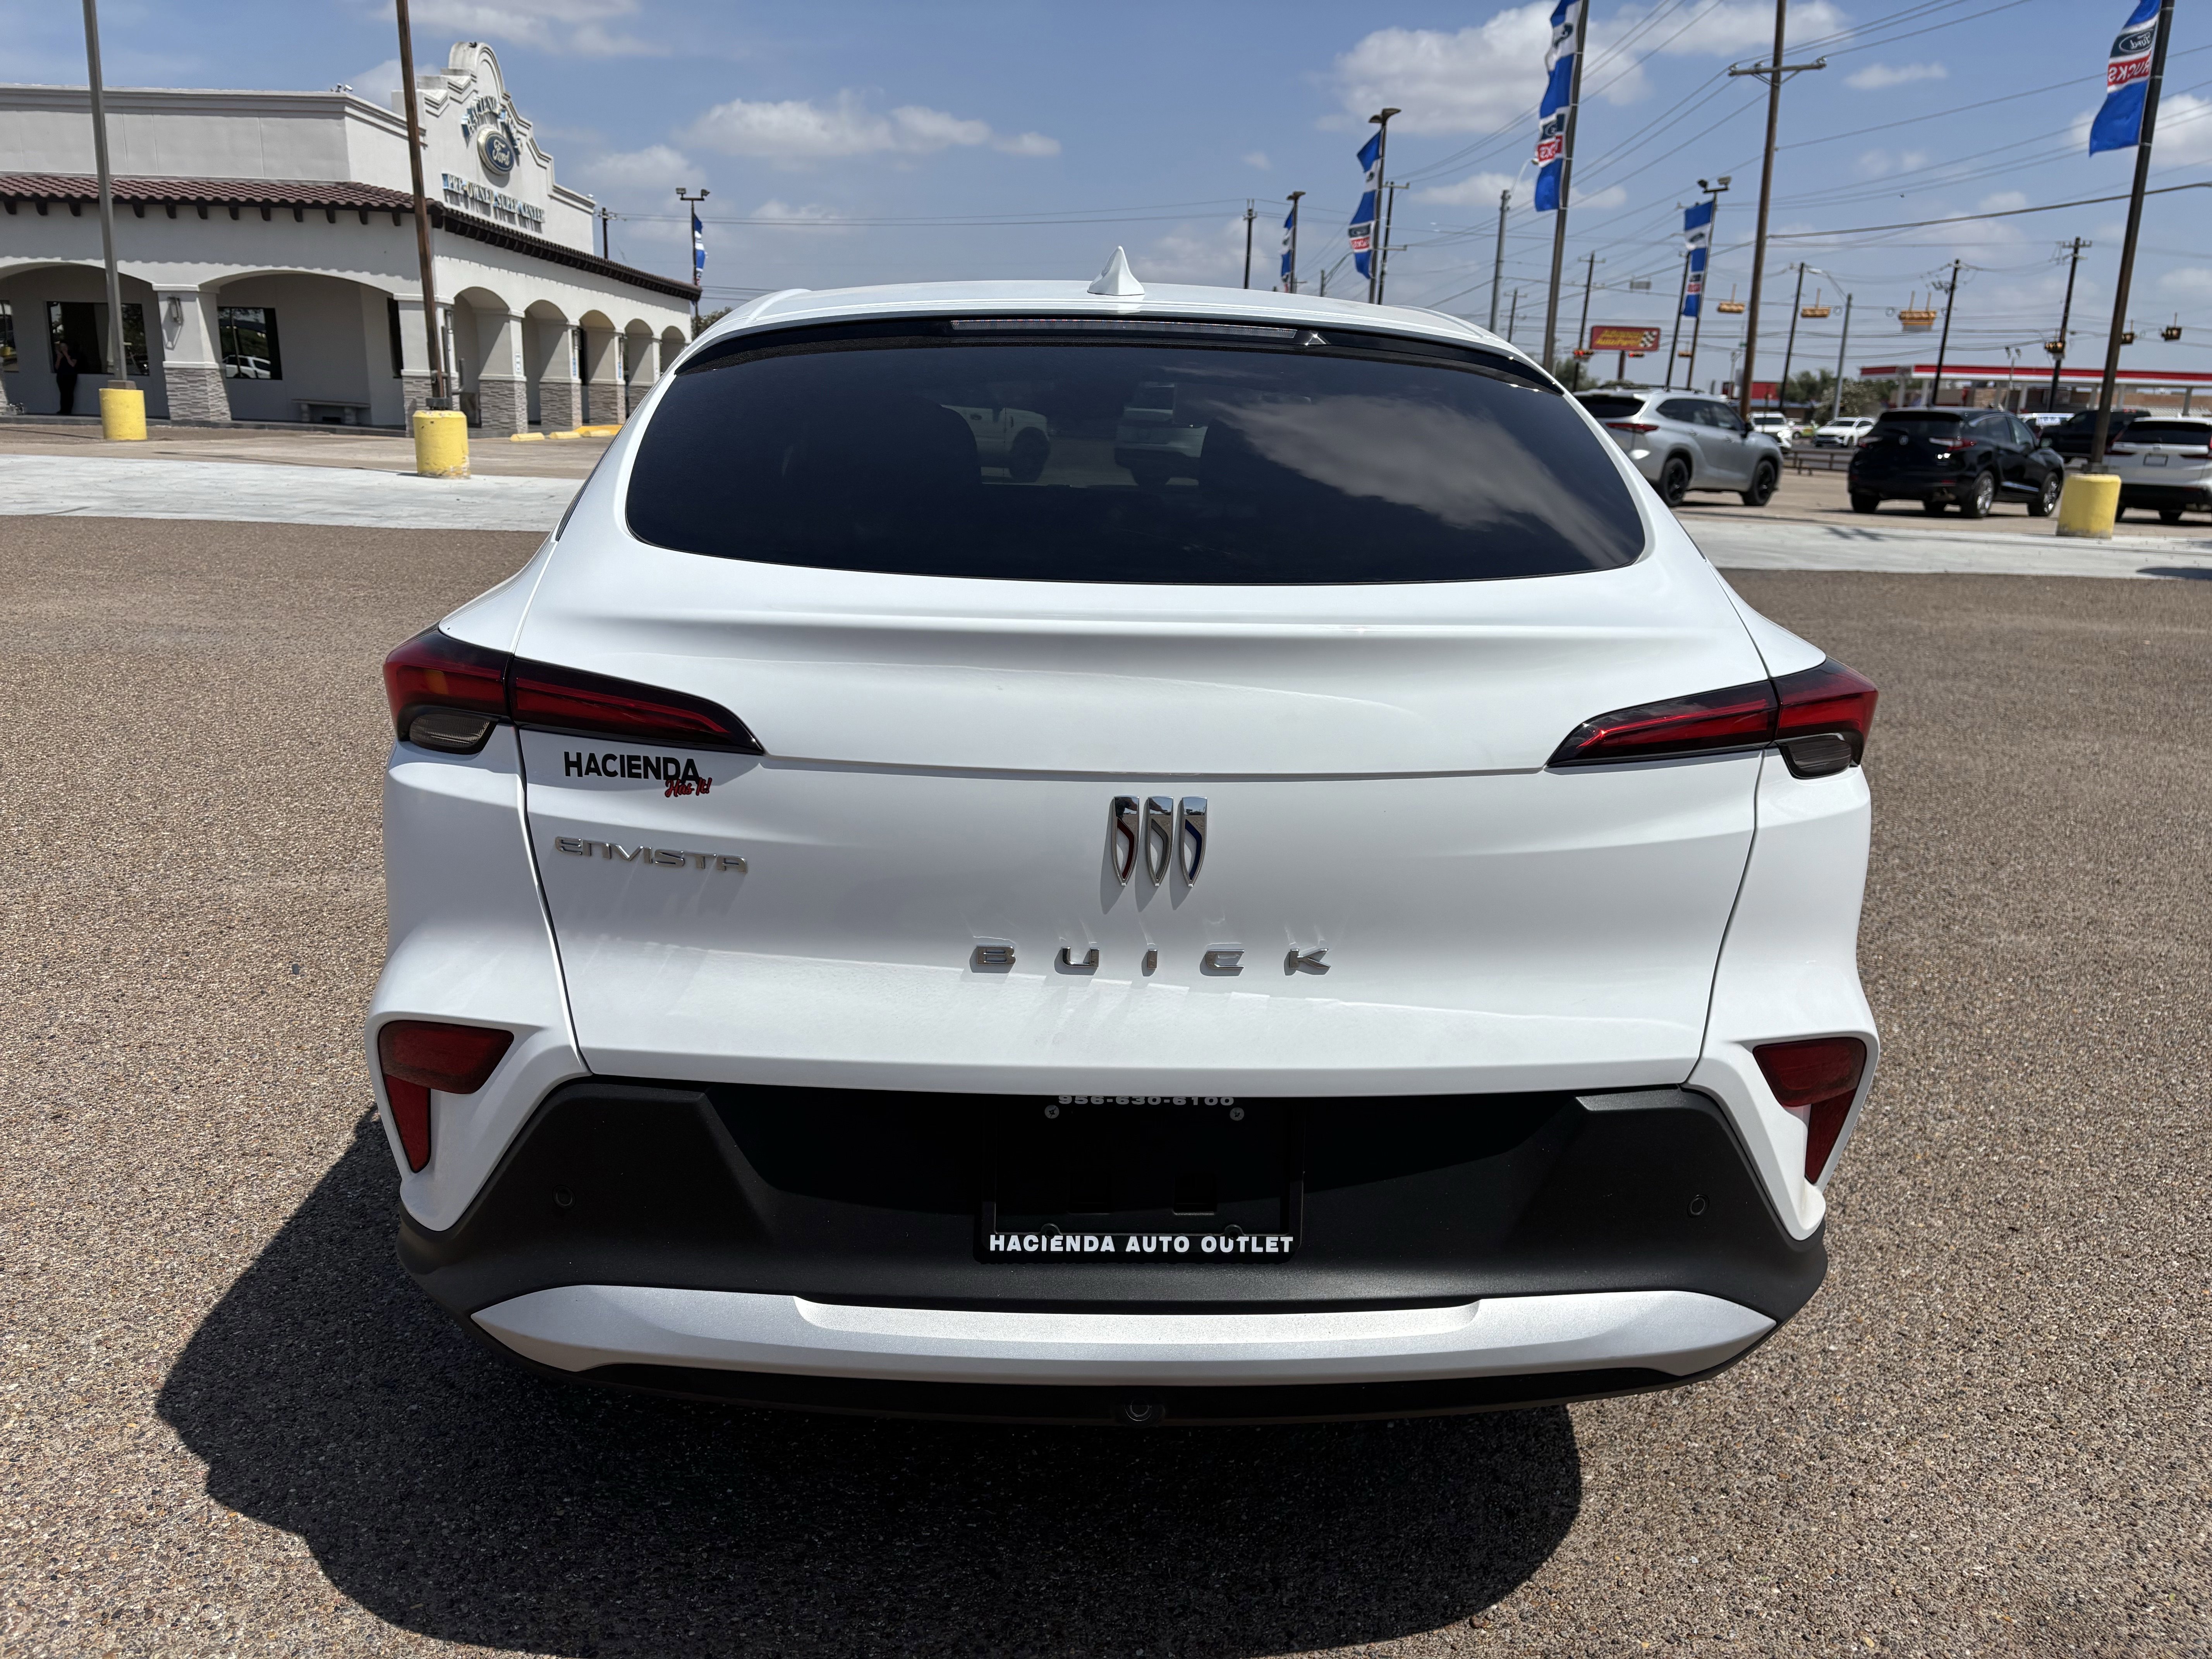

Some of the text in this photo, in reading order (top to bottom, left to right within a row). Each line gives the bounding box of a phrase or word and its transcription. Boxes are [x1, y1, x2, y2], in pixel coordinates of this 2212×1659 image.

[492, 139, 510, 166] Ford
[564, 751, 699, 785] HACIENDA
[664, 777, 713, 798] Has It!
[555, 836, 748, 874] ENVISTA
[976, 944, 1331, 970] BUICK
[1058, 1095, 1234, 1106] 956-630-6100
[990, 1235, 1294, 1253] HACIENDA AUTO OUTLET
